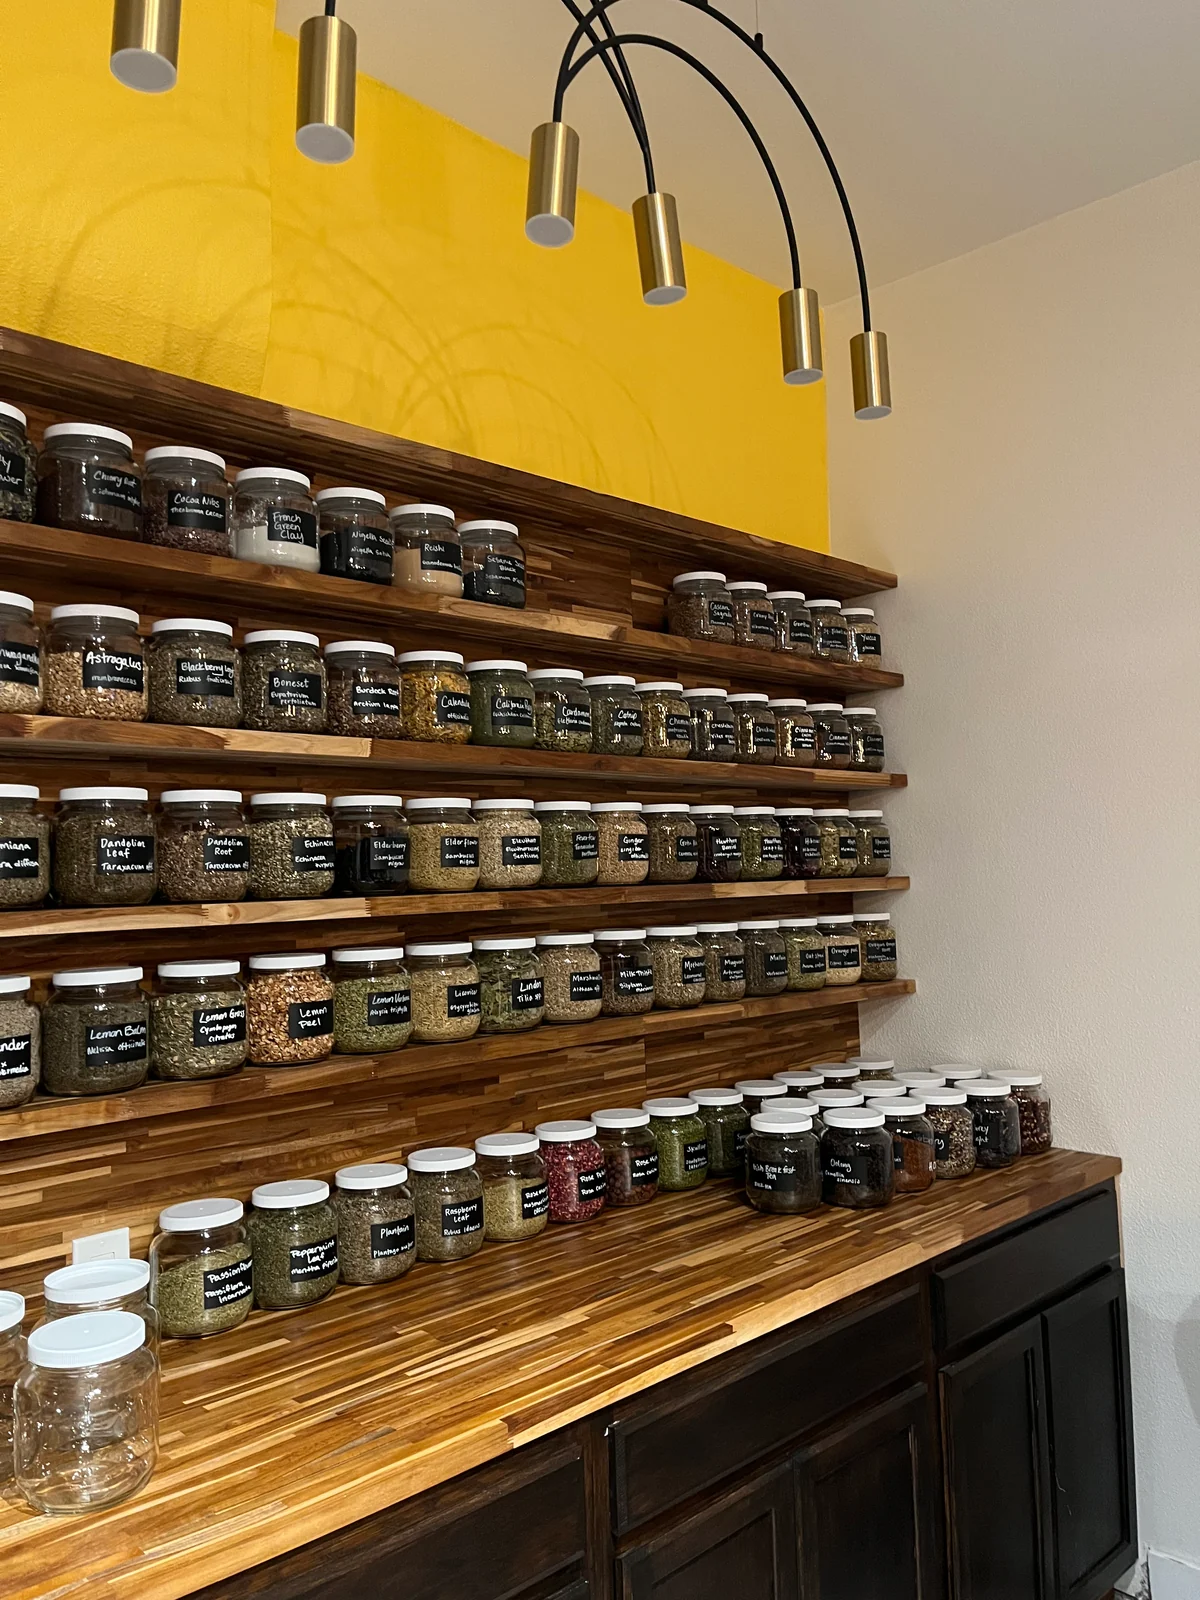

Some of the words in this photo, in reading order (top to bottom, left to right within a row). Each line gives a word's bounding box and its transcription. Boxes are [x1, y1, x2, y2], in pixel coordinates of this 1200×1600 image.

[174, 493, 200, 504] Cocoa
[202, 496, 220, 508] Nibs
[274, 522, 300, 531] Green
[280, 530, 304, 544] Clay
[424, 544, 445, 552] Reishi
[86, 651, 142, 671] Astragalus
[181, 662, 224, 676] Blackberry
[273, 677, 309, 689] Boneset
[355, 686, 386, 694] Burdock
[623, 836, 644, 845] Ginger
[214, 847, 233, 856] Root
[374, 841, 406, 852] Elderberry
[107, 848, 131, 858] Leaf
[101, 862, 145, 872] Taraxacum
[831, 947, 849, 956] Orange
[372, 995, 394, 1005] Lemon
[517, 994, 533, 1003] Tilia
[299, 1006, 327, 1018] Lemon
[199, 1012, 227, 1024] Lemon
[90, 1029, 122, 1040] Lemon
[124, 1025, 146, 1036] Balm
[635, 1158, 649, 1167] Rose
[580, 1174, 594, 1182] Rose
[581, 1187, 594, 1196] Rosa
[445, 1204, 477, 1216] Raspberry
[454, 1214, 469, 1223] Leaf
[380, 1225, 410, 1239] Plantain
[290, 1240, 335, 1258] Peppermint
[373, 1248, 400, 1258] Plantago
[308, 1252, 325, 1264] Leaf
